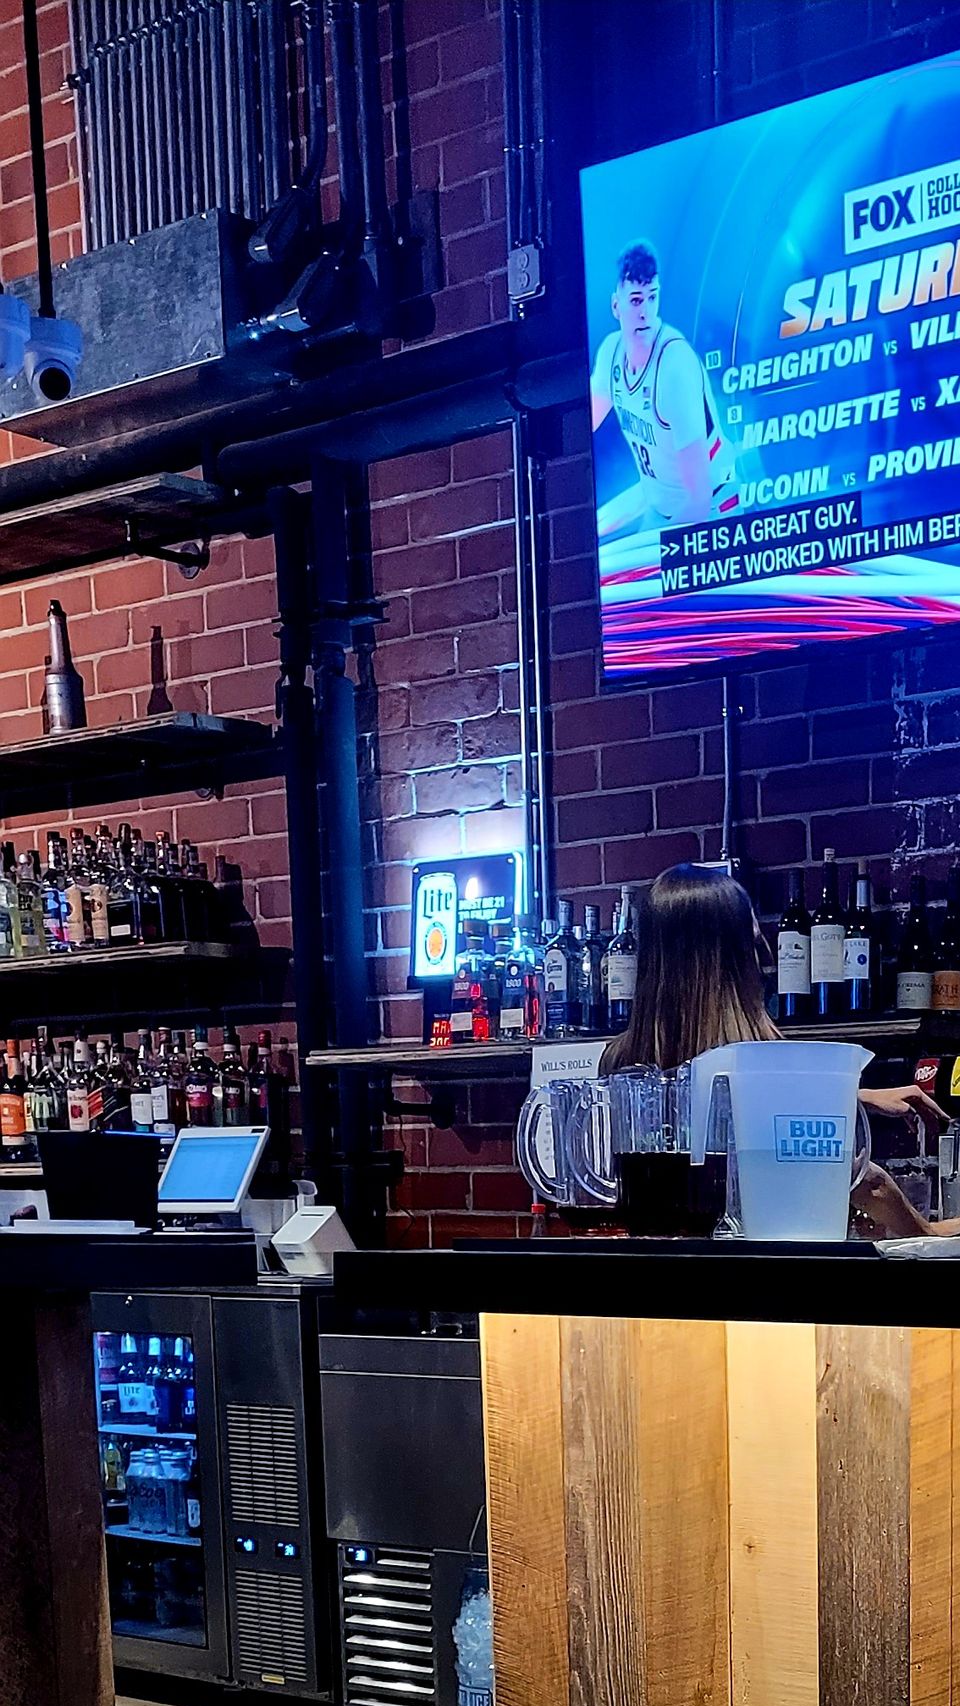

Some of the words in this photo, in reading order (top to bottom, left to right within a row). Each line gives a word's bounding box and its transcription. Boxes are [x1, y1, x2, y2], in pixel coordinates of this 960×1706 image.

[853, 185, 915, 240] FOX
[722, 333, 873, 394] CREIGHTON
[742, 389, 901, 449] MARQUETTE
[740, 465, 830, 509] UCONN
[683, 530, 708, 557] HE
[711, 527, 729, 551] IS
[732, 523, 748, 548] A
[750, 509, 811, 544] GREAT
[814, 500, 857, 531] GUY.
[661, 566, 689, 592] WE
[692, 556, 741, 587] HAVE
[743, 541, 824, 580] WORKED
[827, 529, 879, 561] WITH
[884, 519, 924, 551] HIM
[423, 888, 453, 919] Lite
[568, 1059, 593, 1070] ROLLS
[780, 1139, 843, 1158] LIGHT
[790, 1120, 837, 1139] BUD
